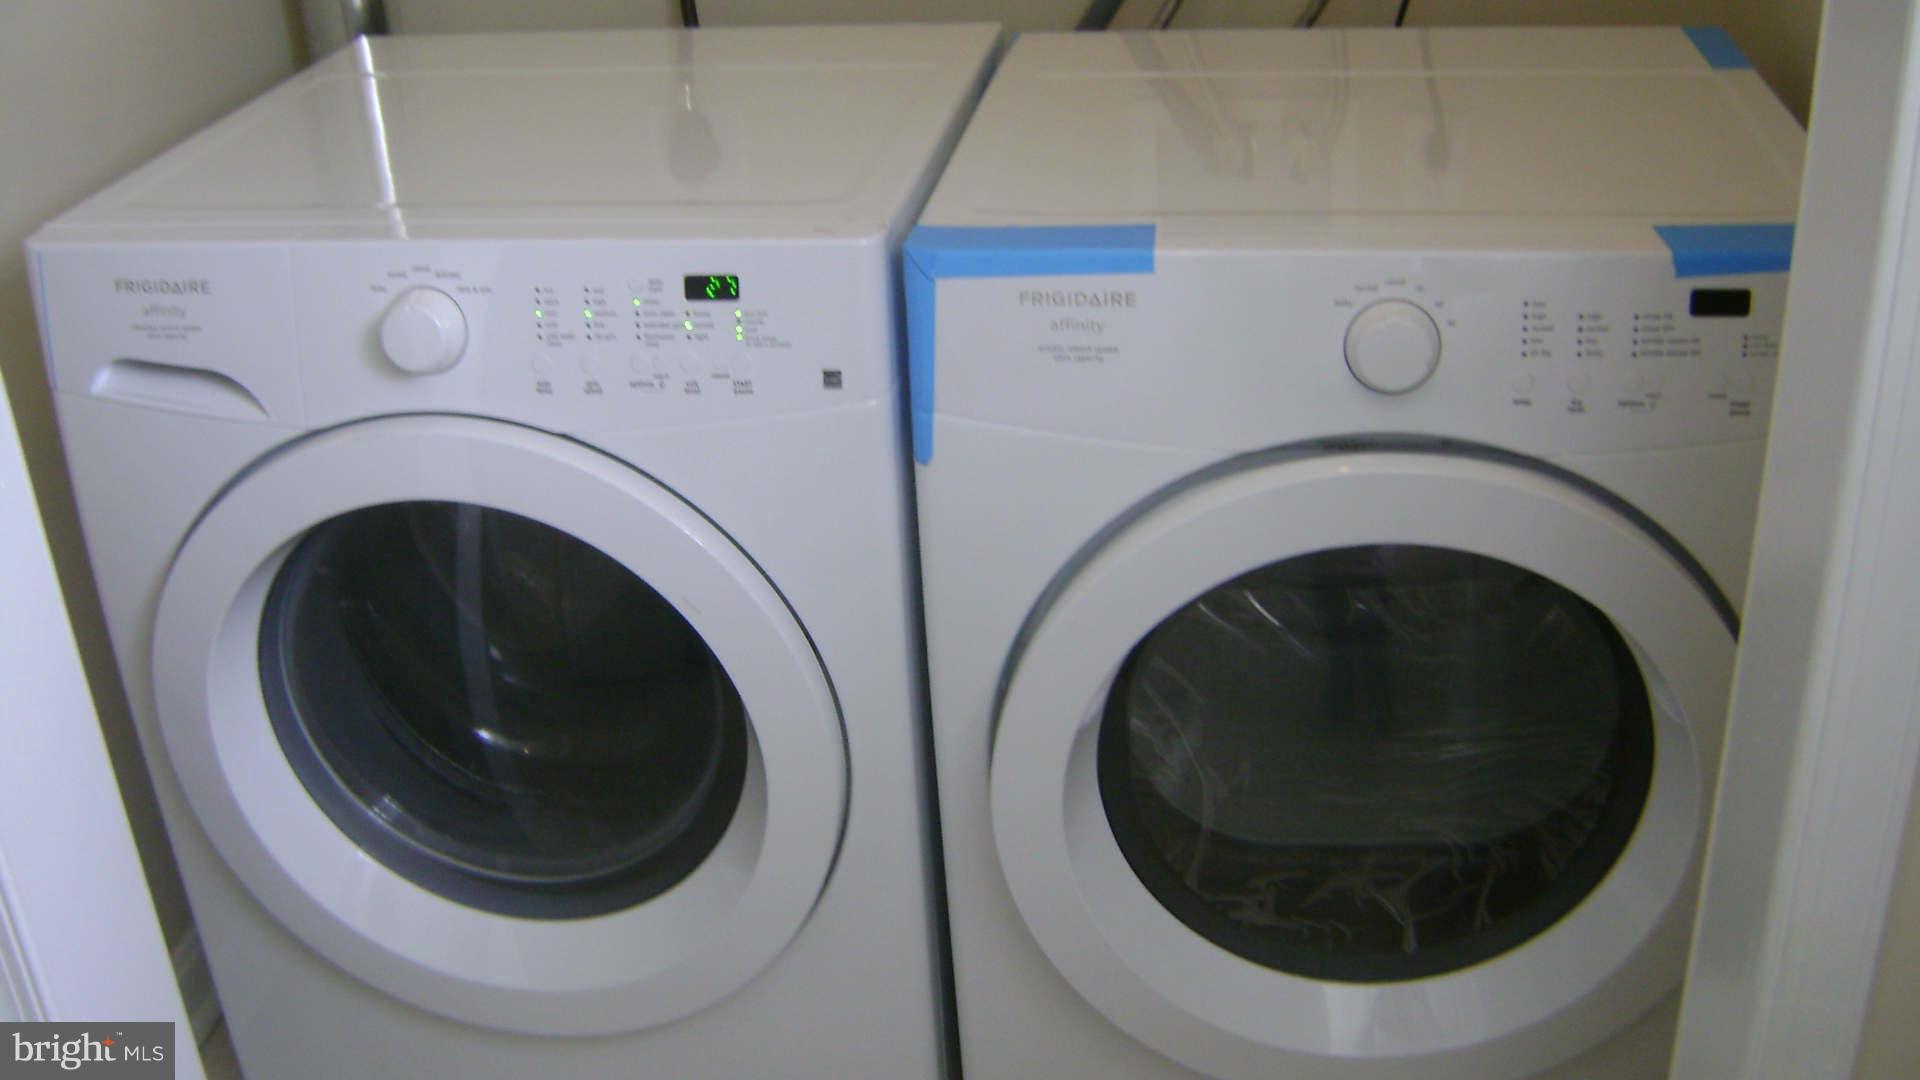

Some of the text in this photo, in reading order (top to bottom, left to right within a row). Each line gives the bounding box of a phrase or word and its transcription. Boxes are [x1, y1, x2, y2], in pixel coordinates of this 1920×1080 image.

[114, 278, 212, 295] FRIGIDAIRE
[1018, 289, 1137, 308] FRIGIDAIRE
[1049, 317, 1105, 335] affinity
